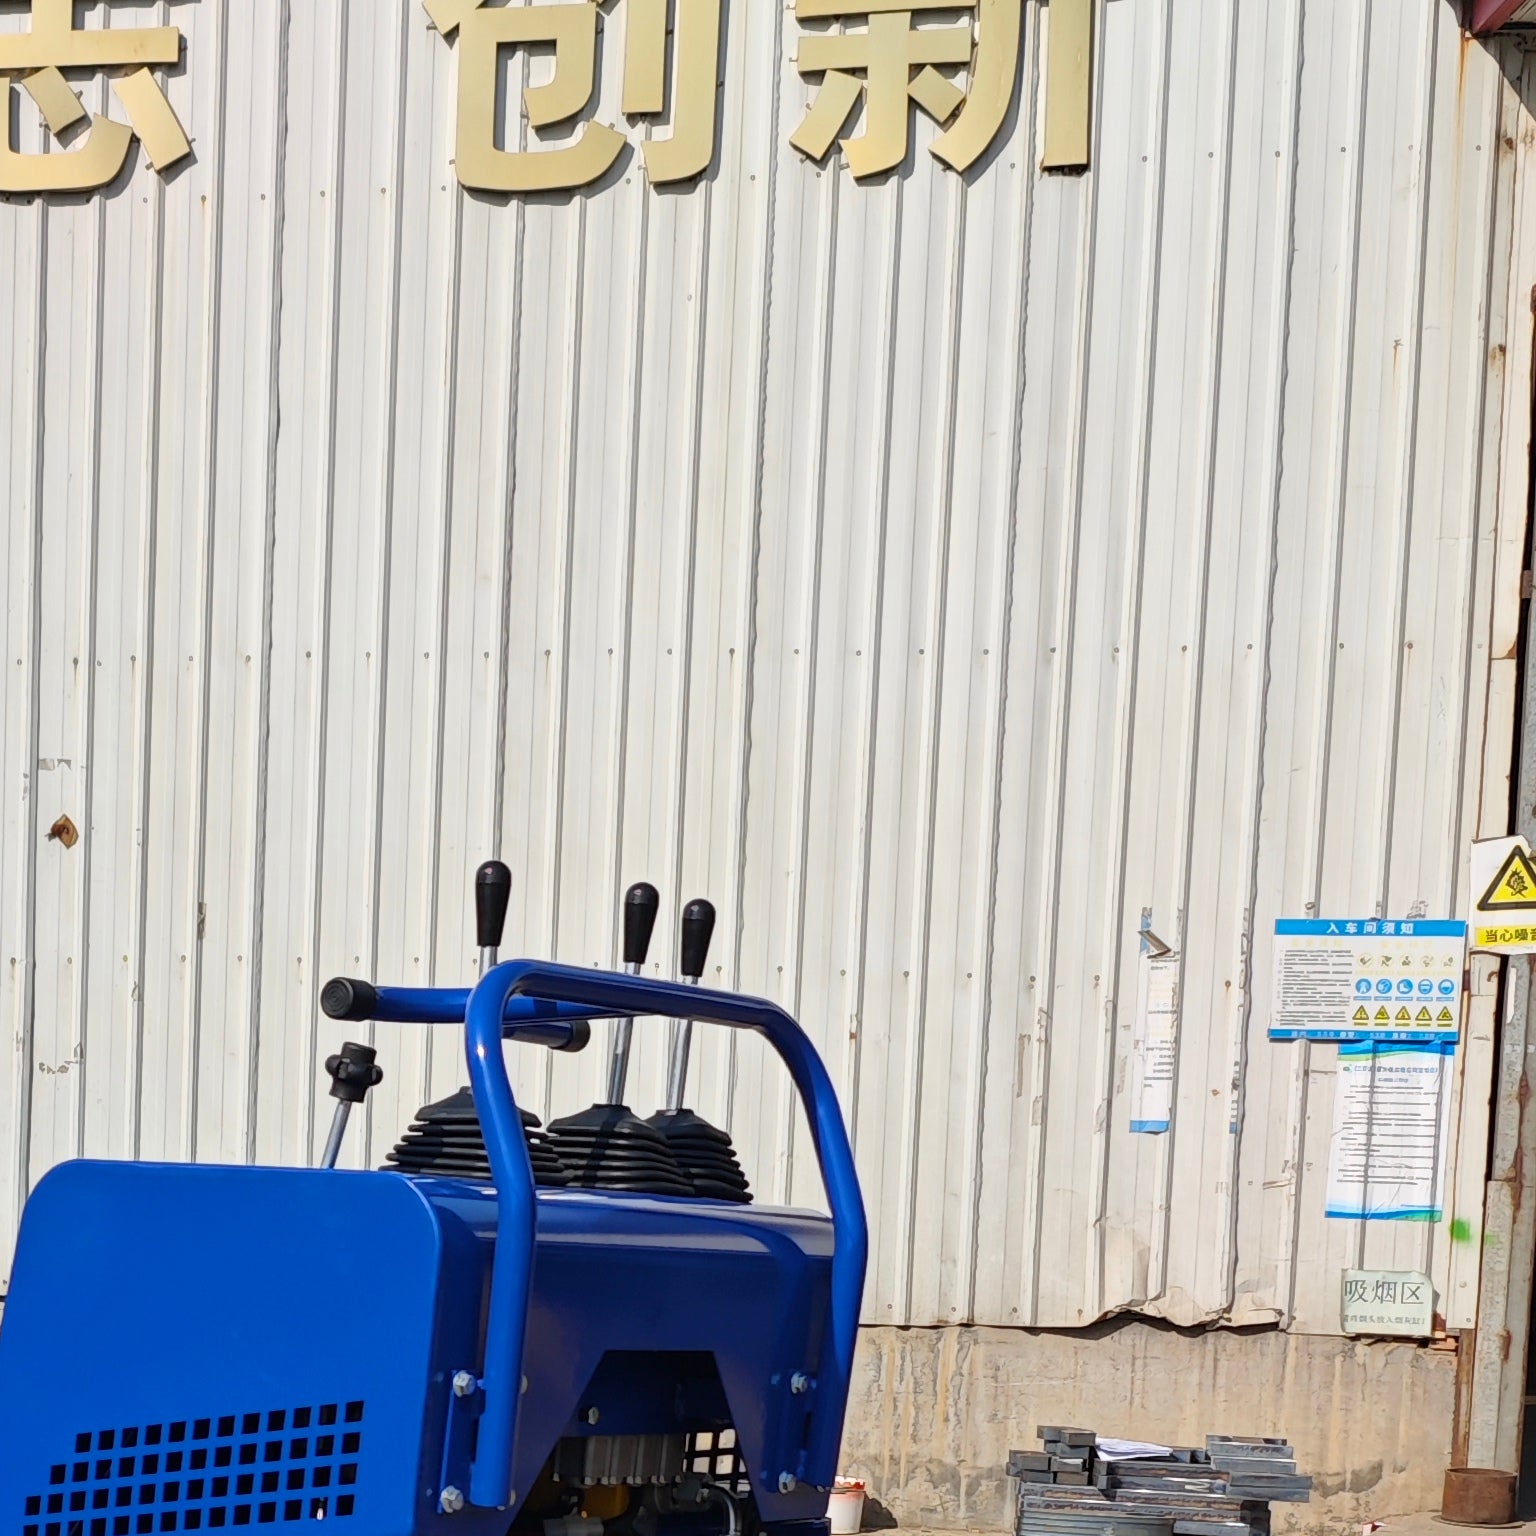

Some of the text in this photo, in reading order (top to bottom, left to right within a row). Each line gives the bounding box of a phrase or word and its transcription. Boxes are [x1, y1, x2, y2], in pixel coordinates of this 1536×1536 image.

[1326, 922, 1414, 935] 入车间须知
[1344, 1280, 1425, 1305] 吸烟区
